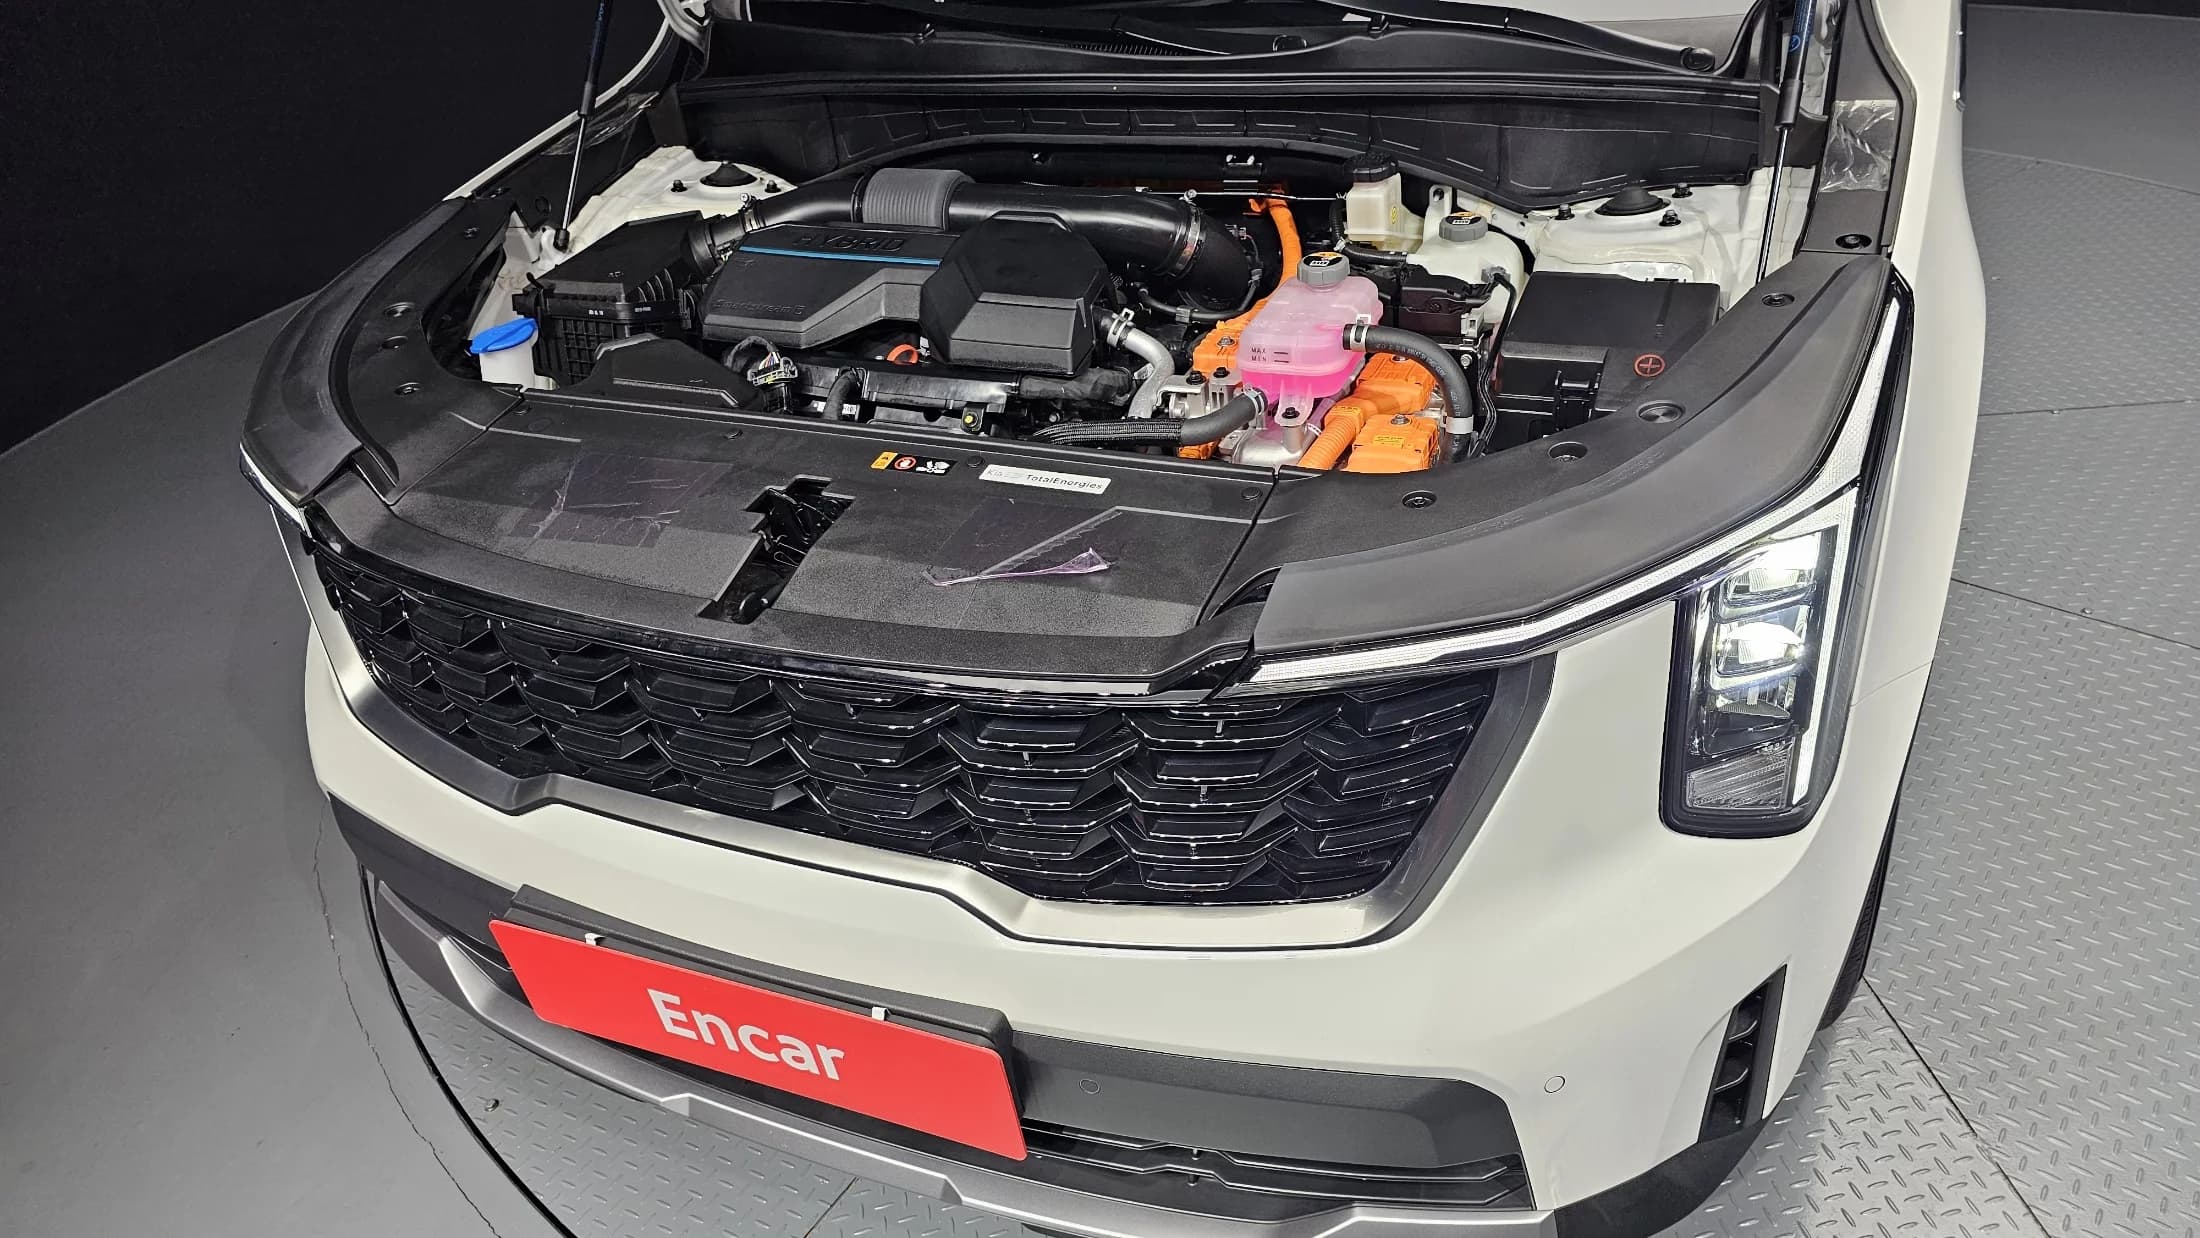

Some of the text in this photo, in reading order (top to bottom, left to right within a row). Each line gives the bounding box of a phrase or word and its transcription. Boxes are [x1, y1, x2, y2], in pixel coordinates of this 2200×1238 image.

[793, 231, 905, 252] HYBRID
[1026, 473, 1103, 490] TotalEnergies
[647, 988, 845, 1081] Encar
